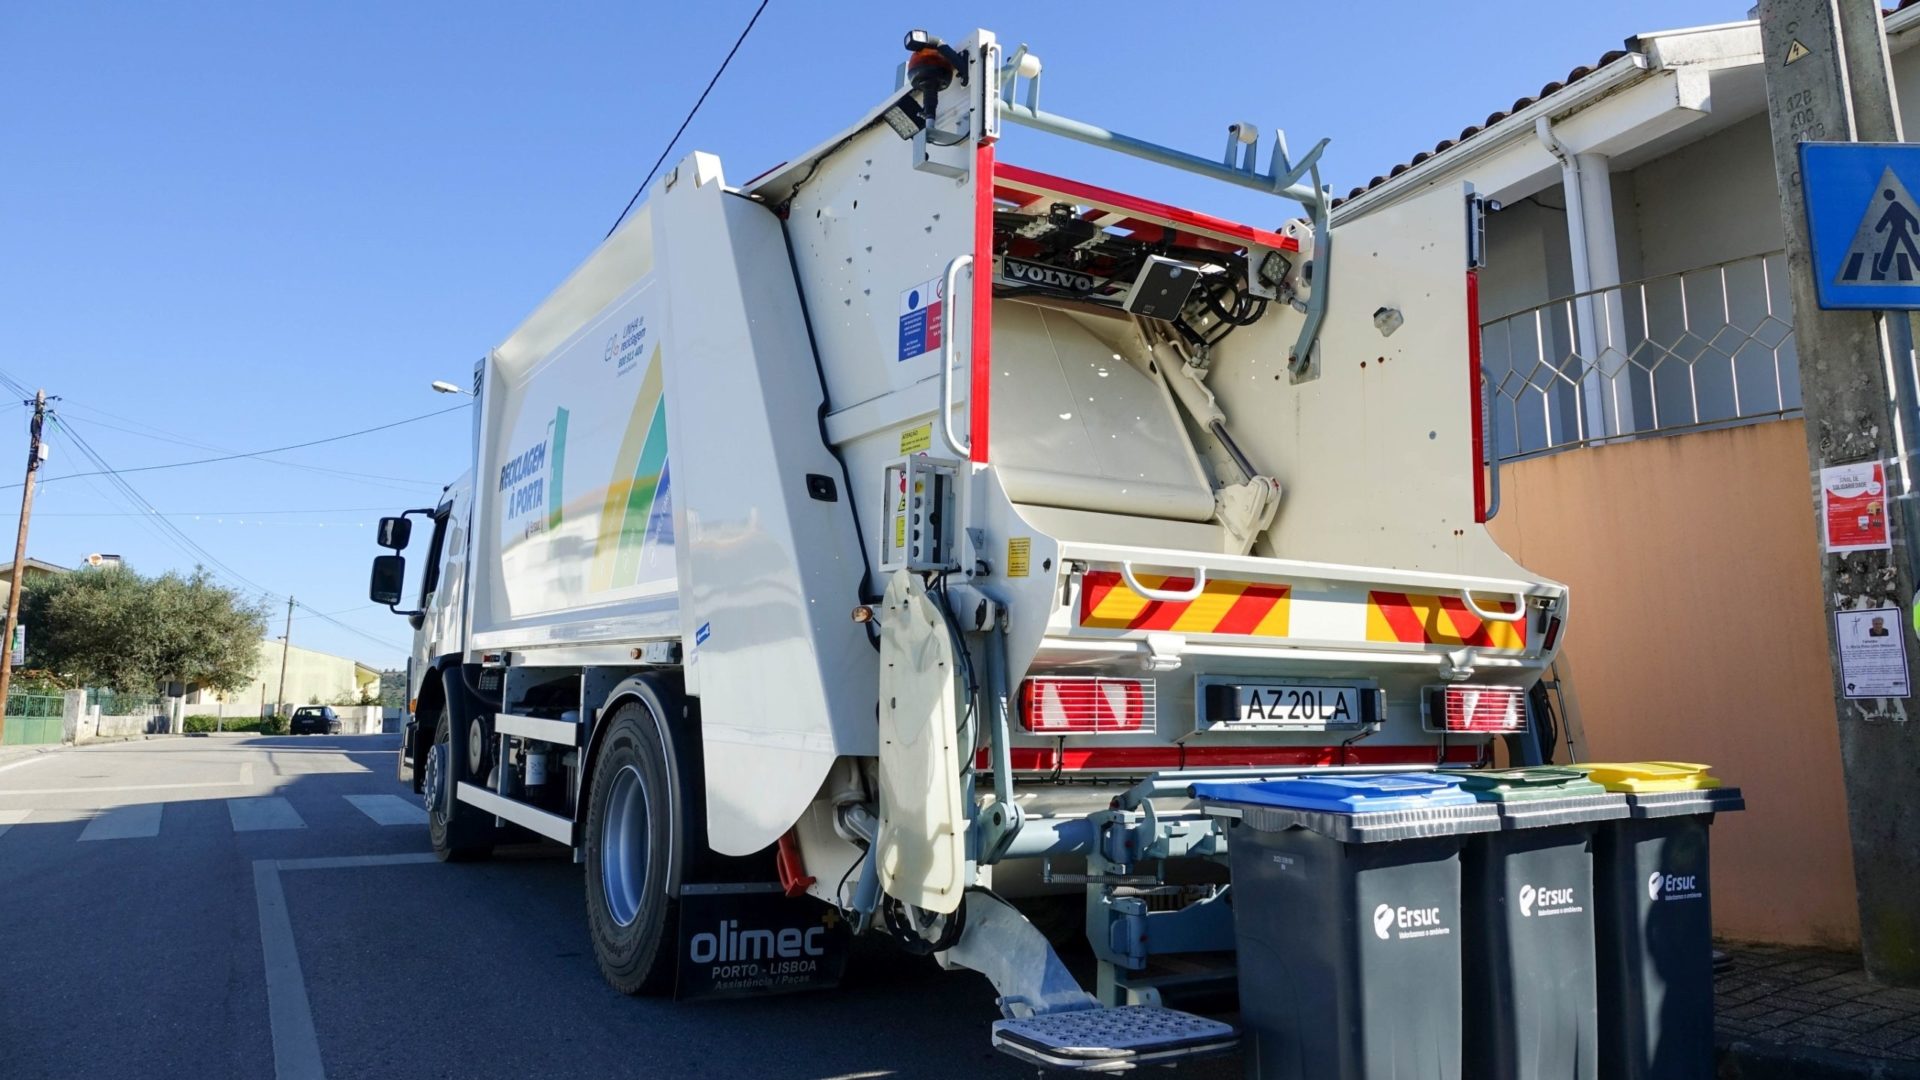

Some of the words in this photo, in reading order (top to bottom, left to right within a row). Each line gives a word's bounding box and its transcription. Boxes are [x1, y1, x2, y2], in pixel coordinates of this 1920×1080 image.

[1007, 261, 1091, 291] VOLVO
[499, 440, 546, 493] RECICLAGEM
[515, 478, 543, 517] PORTA
[1665, 874, 1696, 892] Ersuc
[1538, 887, 1573, 906] Ersuc
[1397, 906, 1440, 928] Ersuc
[690, 919, 825, 963] olimec
[712, 964, 758, 979] PORTO
[770, 960, 817, 975] LISBOA
[714, 977, 773, 991] Assistência
[781, 974, 810, 985] Peças
